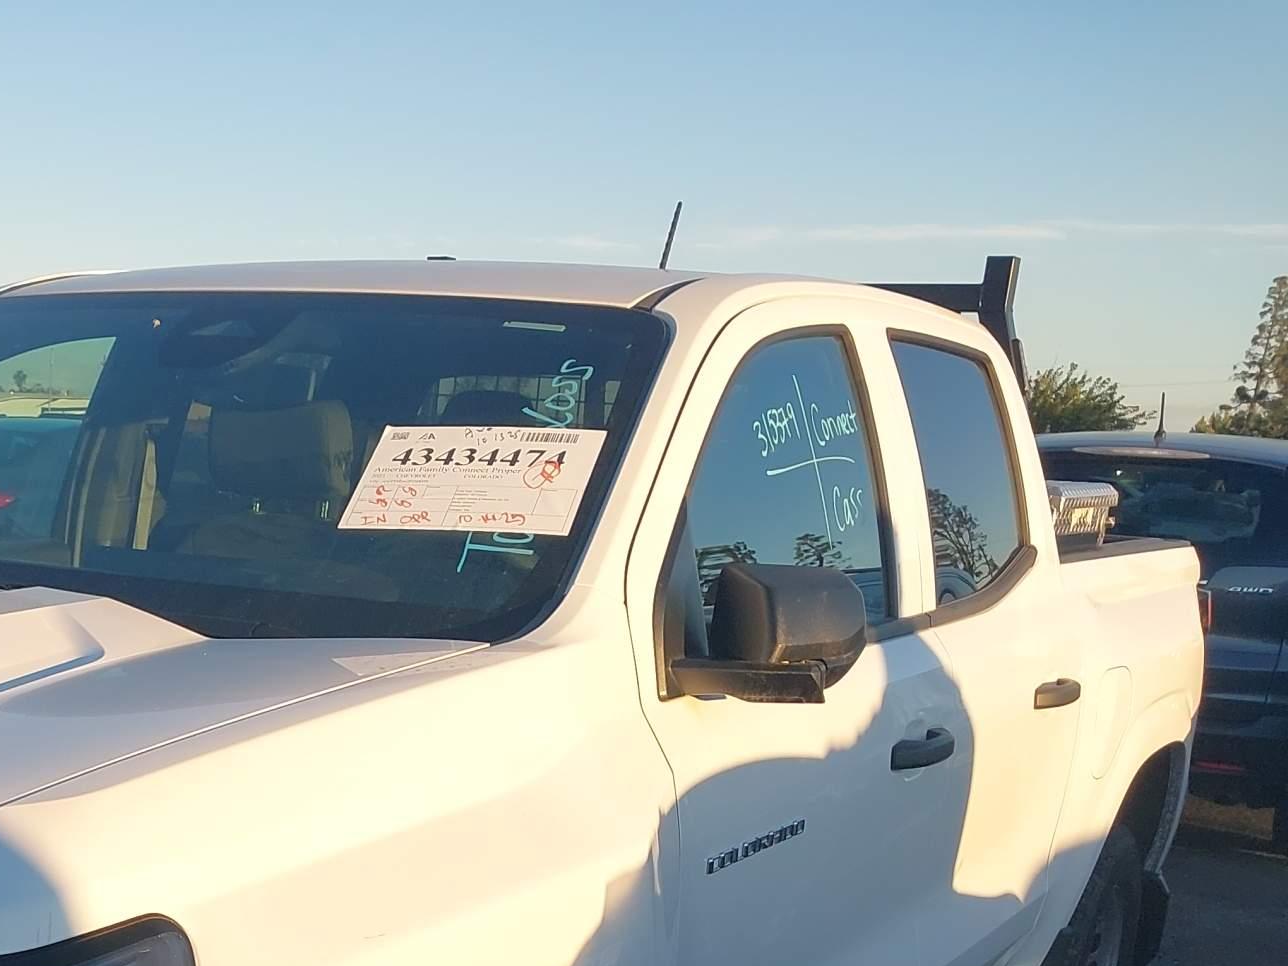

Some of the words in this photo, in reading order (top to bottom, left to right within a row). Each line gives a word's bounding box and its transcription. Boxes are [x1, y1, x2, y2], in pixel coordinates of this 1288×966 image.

[811, 400, 858, 446] Connect
[392, 446, 567, 468] 43434474
[418, 466, 450, 475] Family
[491, 468, 523, 476] Proper
